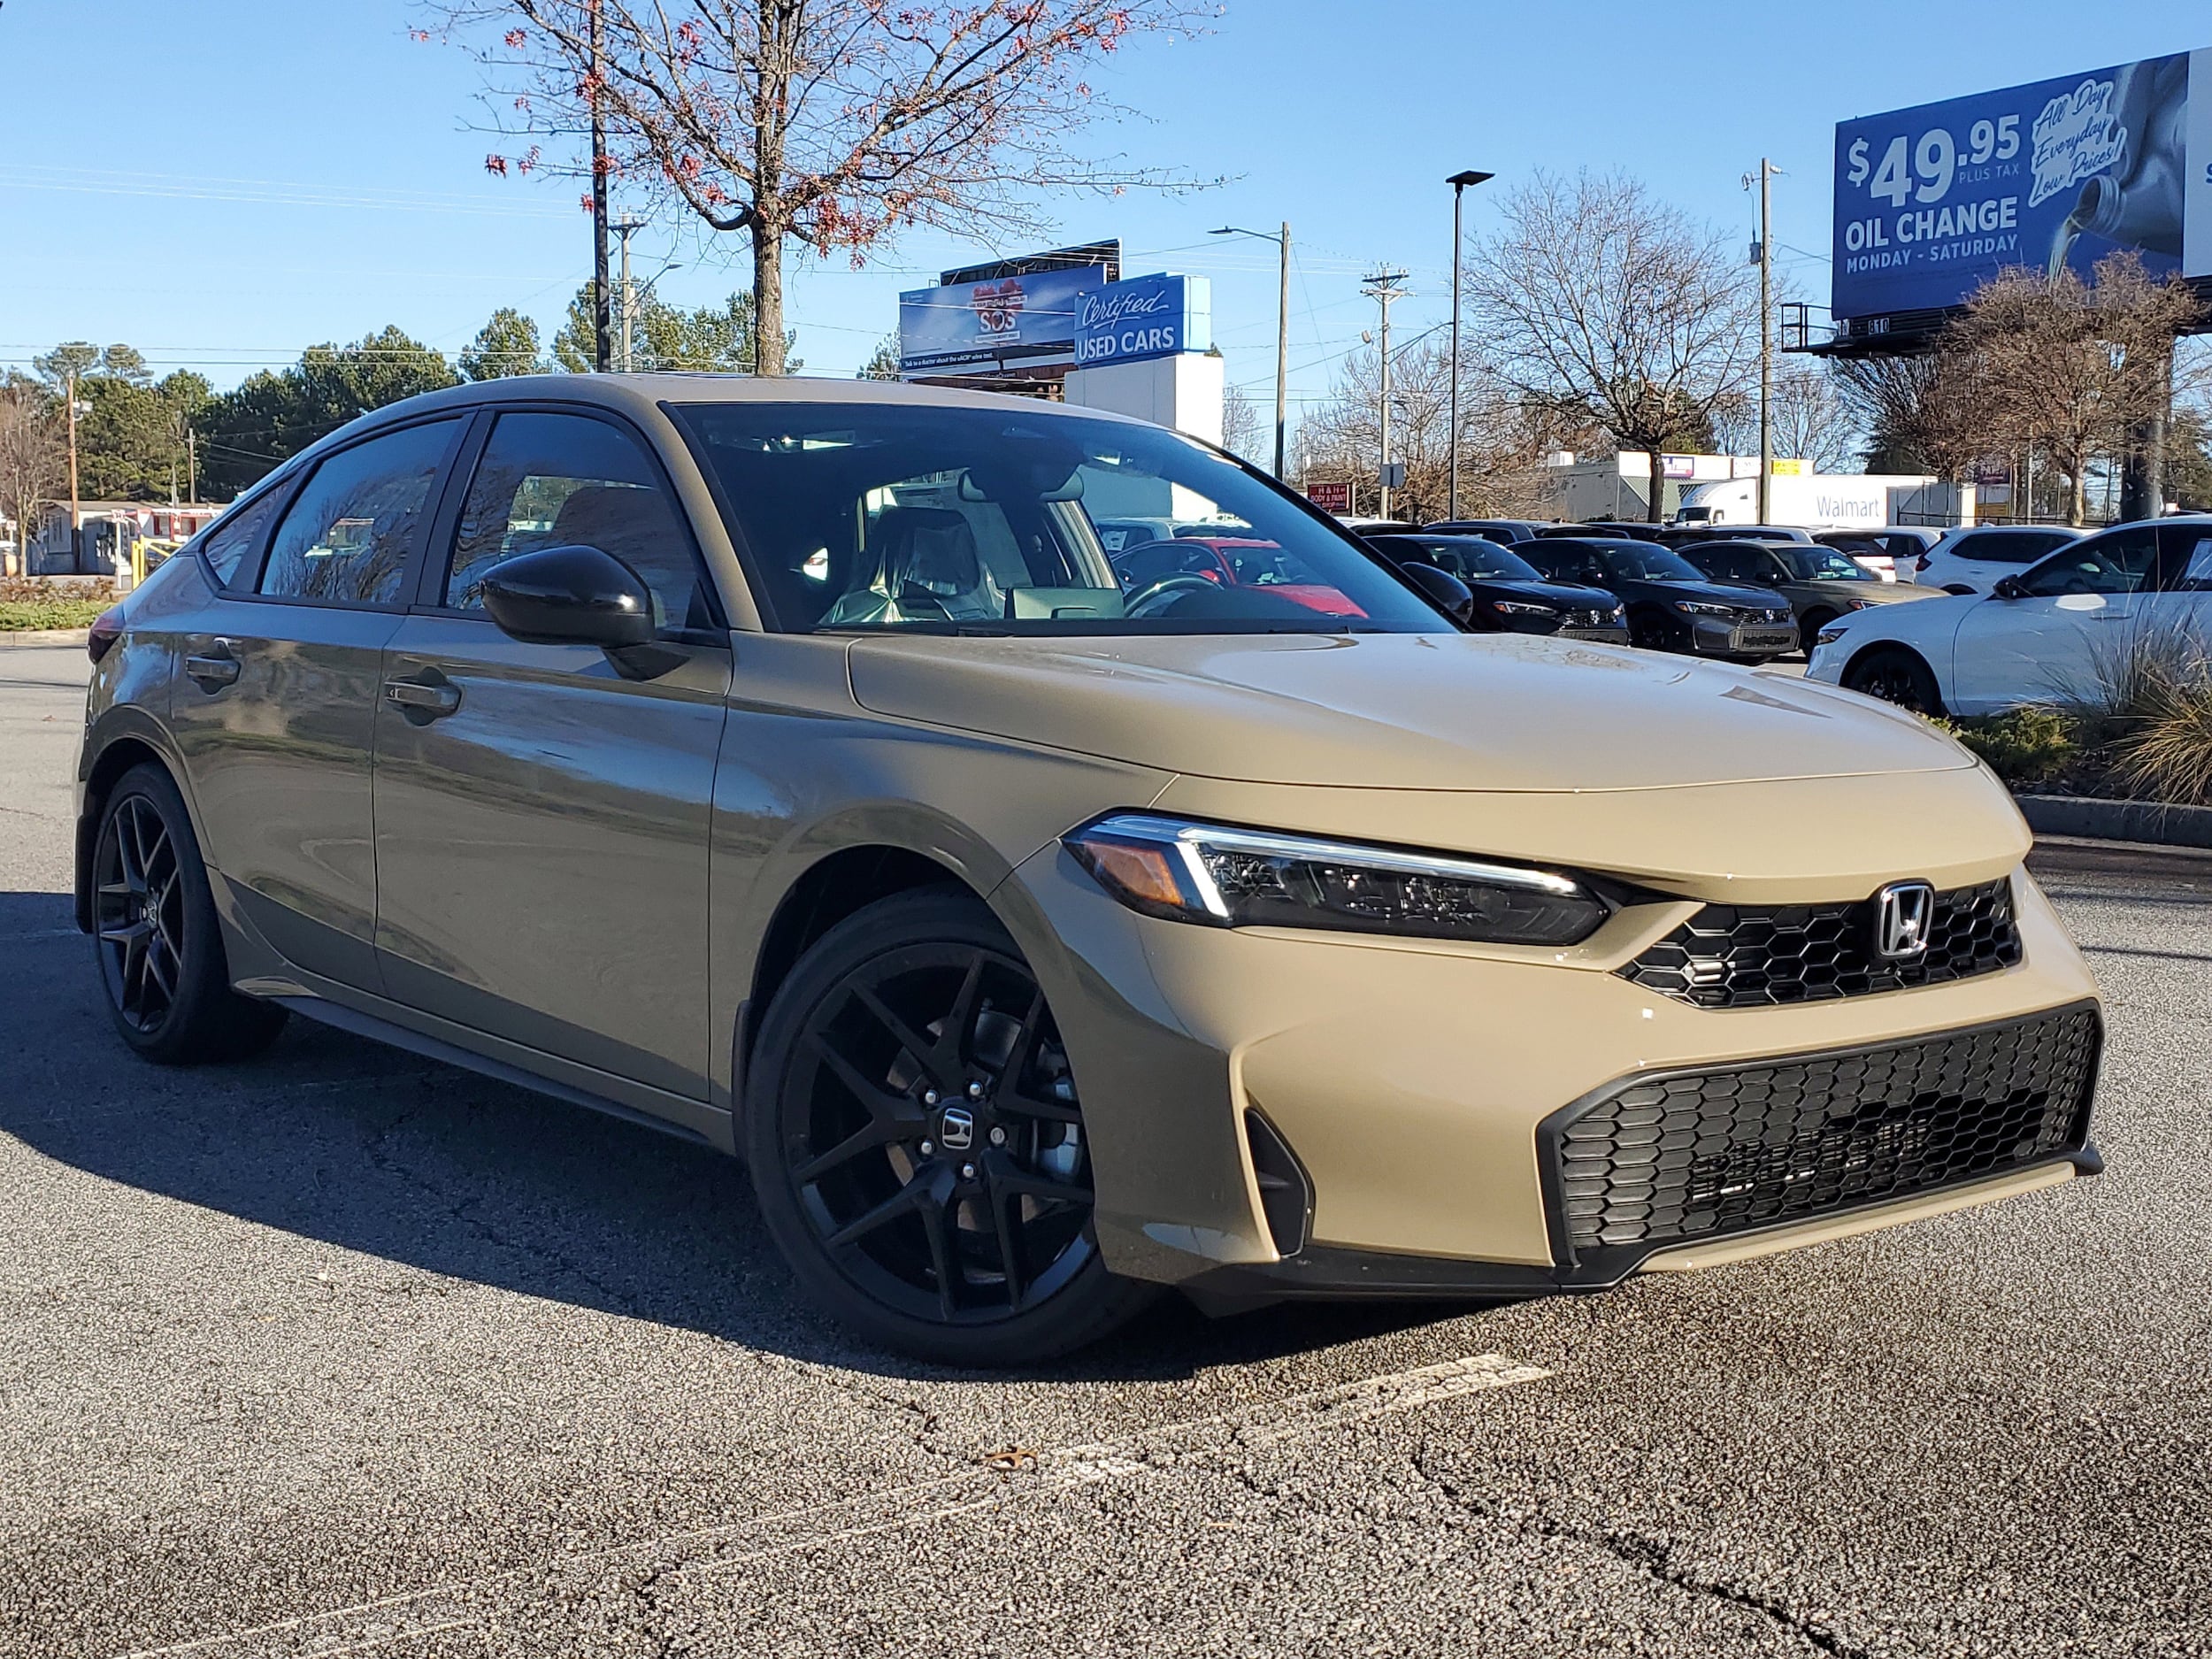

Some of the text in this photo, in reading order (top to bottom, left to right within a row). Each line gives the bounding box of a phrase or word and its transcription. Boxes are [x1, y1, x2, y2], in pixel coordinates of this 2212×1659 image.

[2035, 84, 2110, 139] All Day
[1847, 114, 2021, 208] $49.95
[2035, 116, 2110, 169] Everyday
[1959, 162, 2020, 185] PLUS TAX
[2032, 132, 2124, 204] Low Prices!
[1845, 196, 2018, 251] OIL CHANGE
[1847, 249, 1911, 274] MONDAY
[1929, 234, 2018, 262] SATURDAY
[979, 311, 1016, 333] SOS
[1082, 289, 1169, 330] Certified
[1869, 319, 1889, 334] 810
[1079, 326, 1175, 361] USED CARS
[1816, 495, 1879, 517] Walmart
